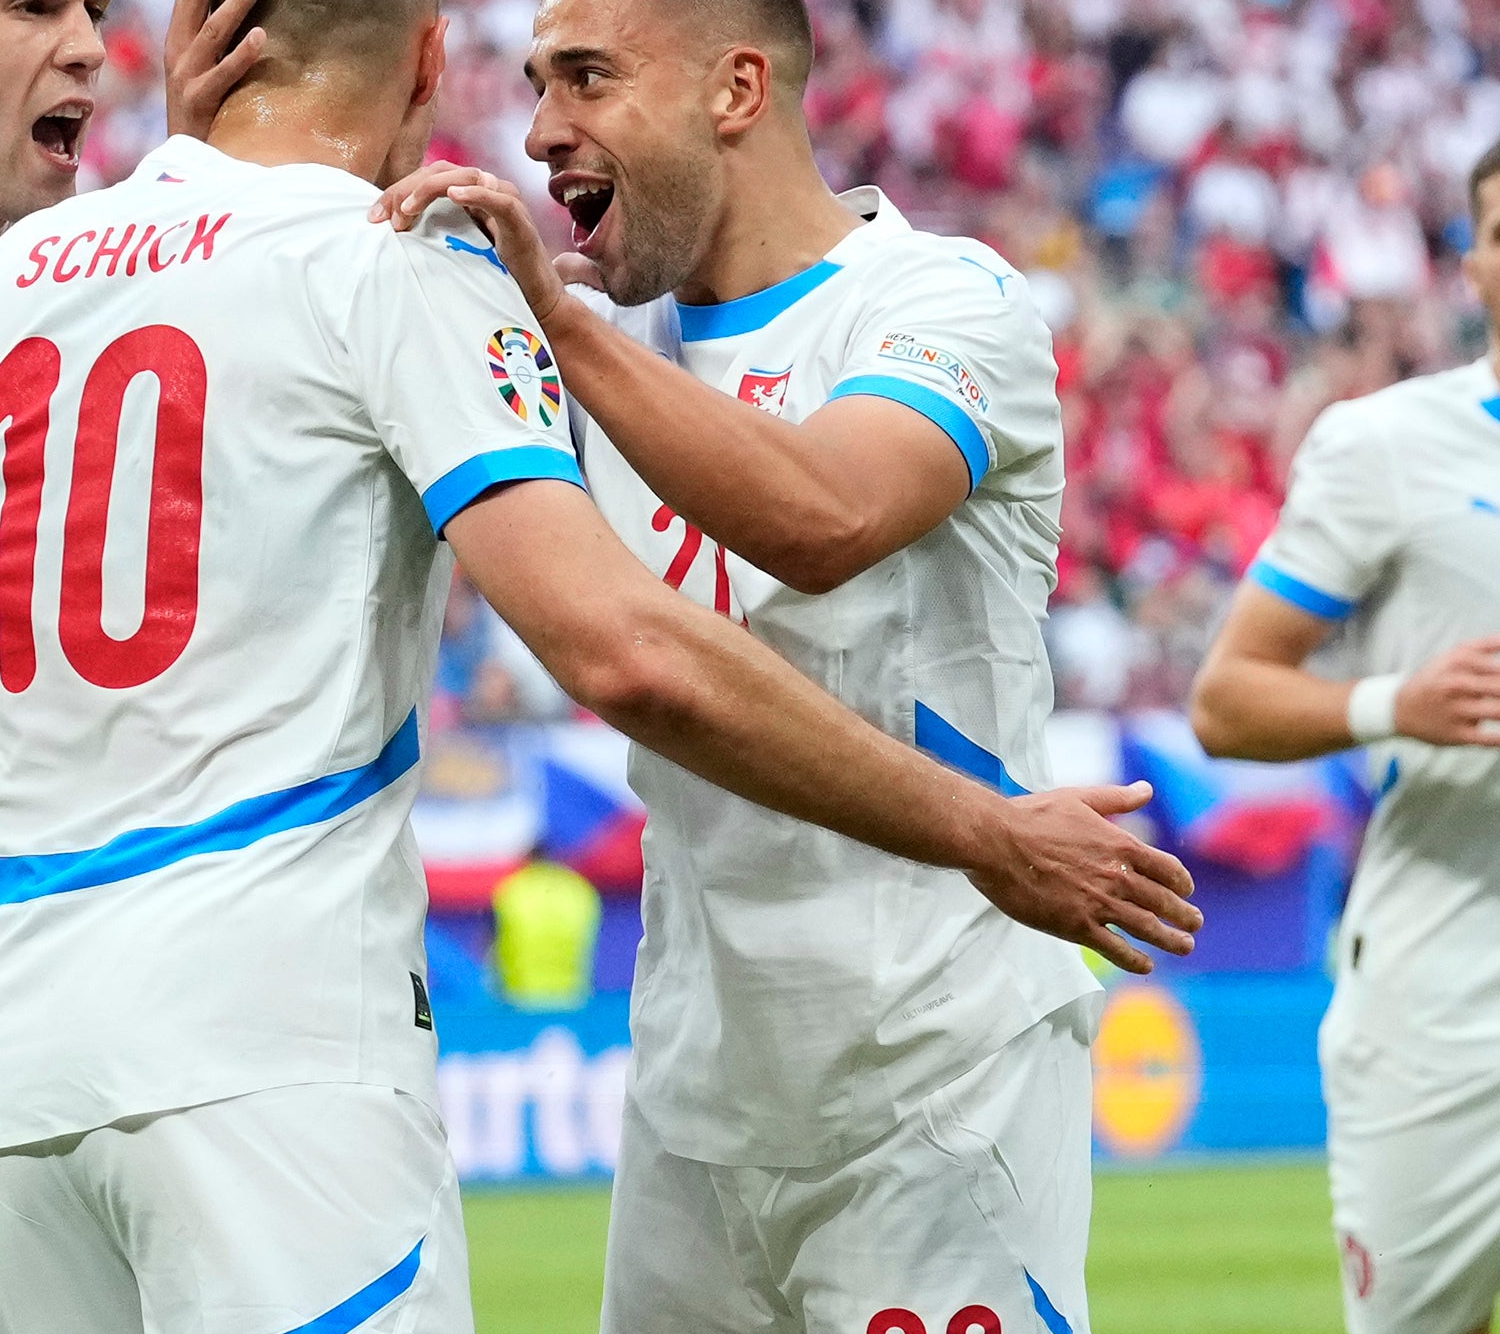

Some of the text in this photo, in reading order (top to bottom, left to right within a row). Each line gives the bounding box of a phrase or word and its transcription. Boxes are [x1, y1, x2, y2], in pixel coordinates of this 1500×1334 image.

[16, 213, 232, 288] SCHICK
[885, 332, 915, 344] UEFA
[879, 340, 988, 413] FOUNDATION
[902, 992, 954, 1020] ULTRAWEAVE
